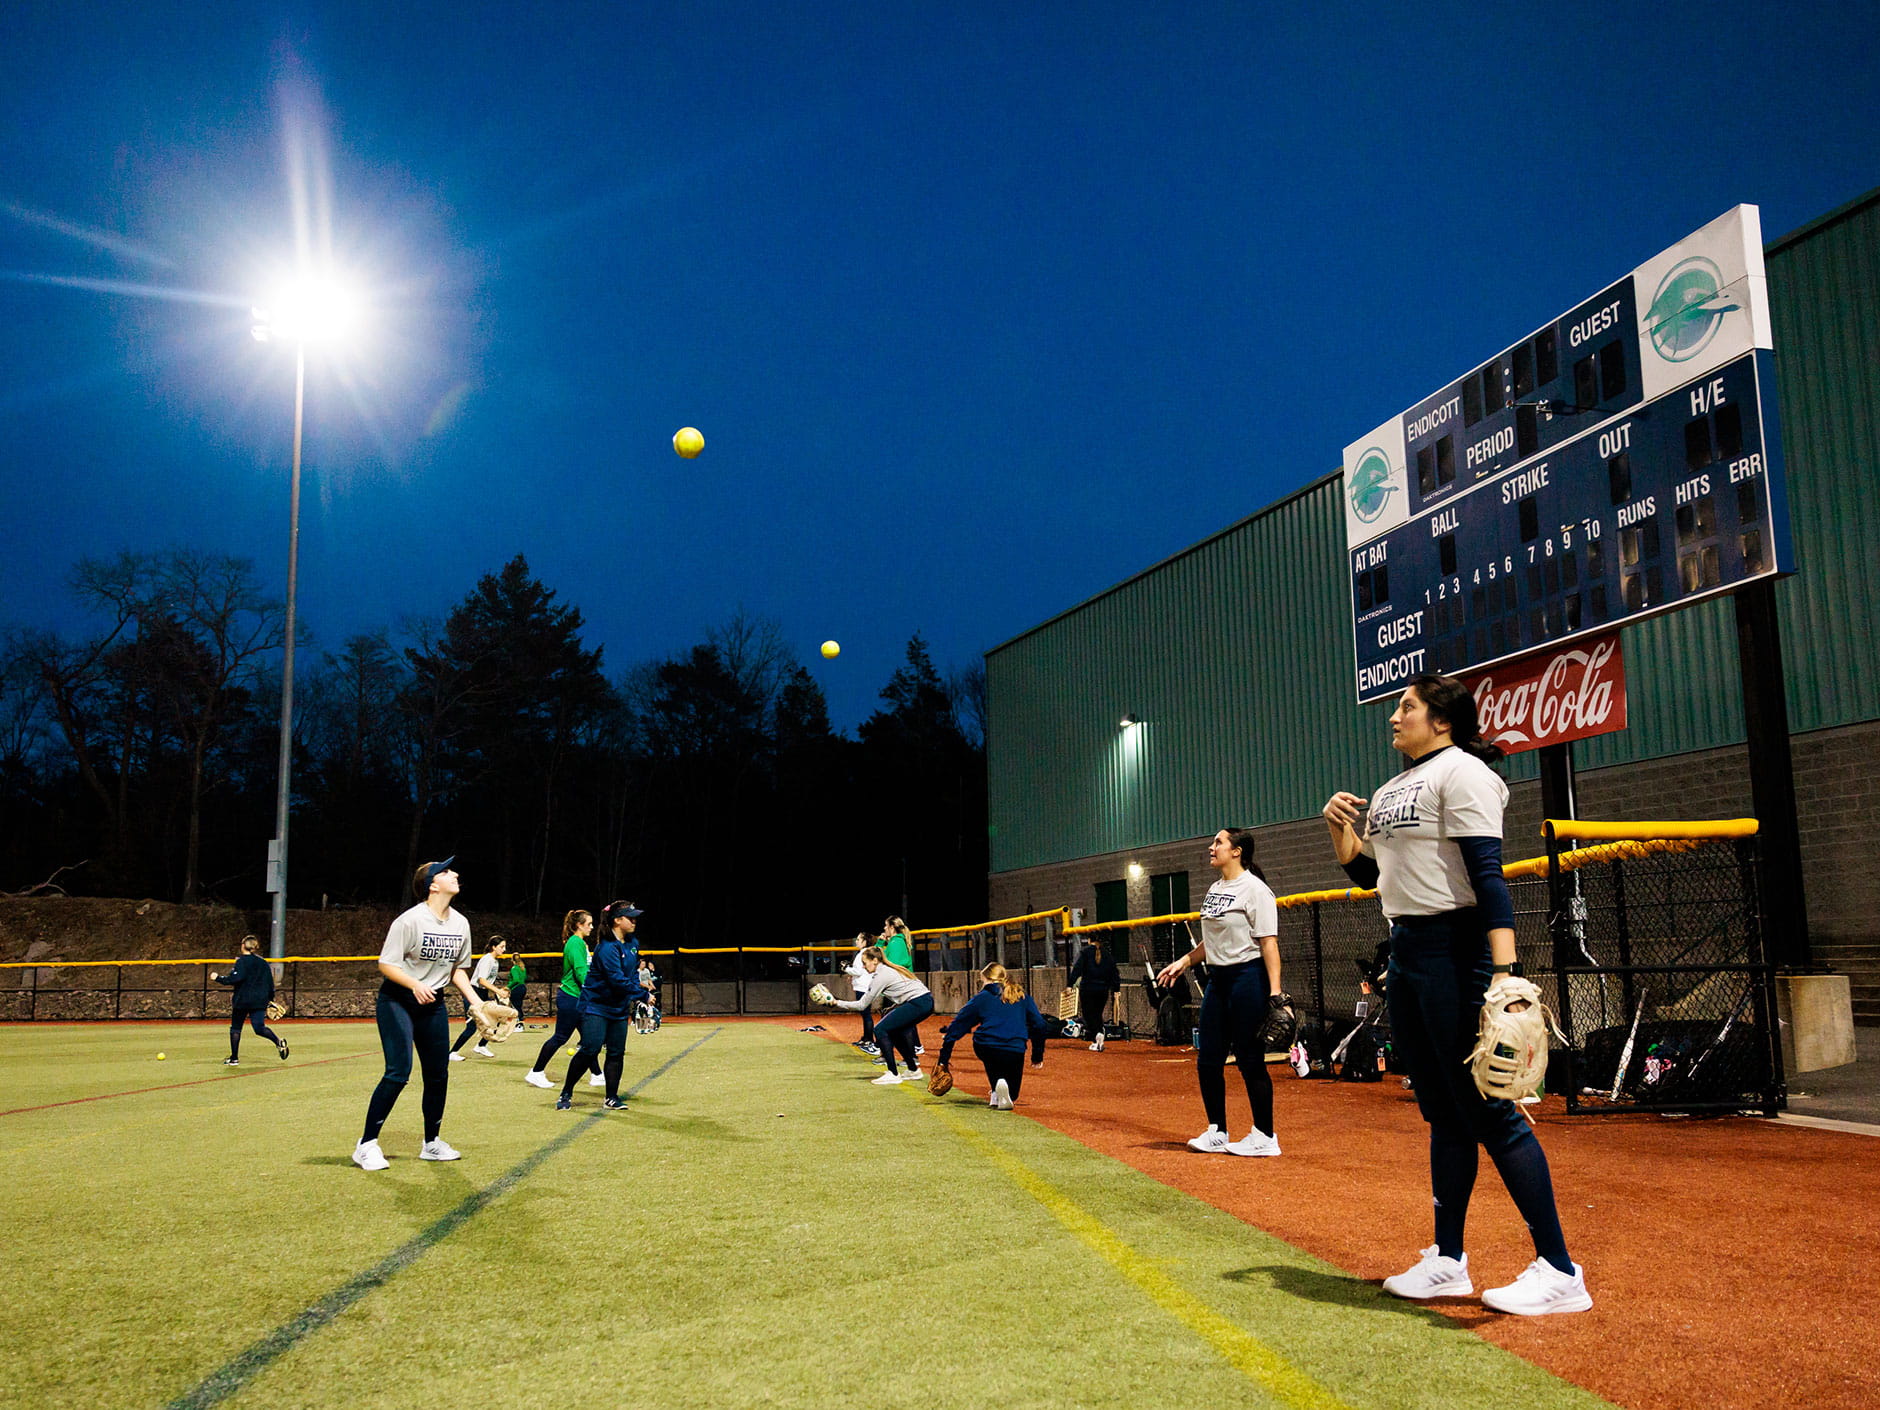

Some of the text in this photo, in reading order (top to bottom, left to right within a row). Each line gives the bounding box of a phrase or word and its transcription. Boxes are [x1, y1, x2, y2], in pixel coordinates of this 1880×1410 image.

[1569, 300, 1621, 348] GUEST
[1690, 377, 1726, 417] H/E
[1407, 396, 1460, 443] ENDICOTT
[1466, 426, 1514, 469] PERIOD
[1599, 422, 1632, 459] OUT
[1501, 462, 1550, 505] STRIKE
[1729, 453, 1762, 484] ERR
[1675, 474, 1711, 505] HITS
[1431, 507, 1460, 538] BALL
[1617, 496, 1656, 529] RUNS
[1355, 540, 1388, 574] AT BAT
[1425, 519, 1600, 605] 1 2 3 4 5 6 7 8 9 10
[1357, 604, 1393, 624] DAKTRONICS
[1377, 611, 1423, 649] GUEST
[1359, 648, 1425, 692] ENDICOTT
[420, 948, 460, 959] SOFTBAL
[422, 936, 462, 948] ENDICOTT
